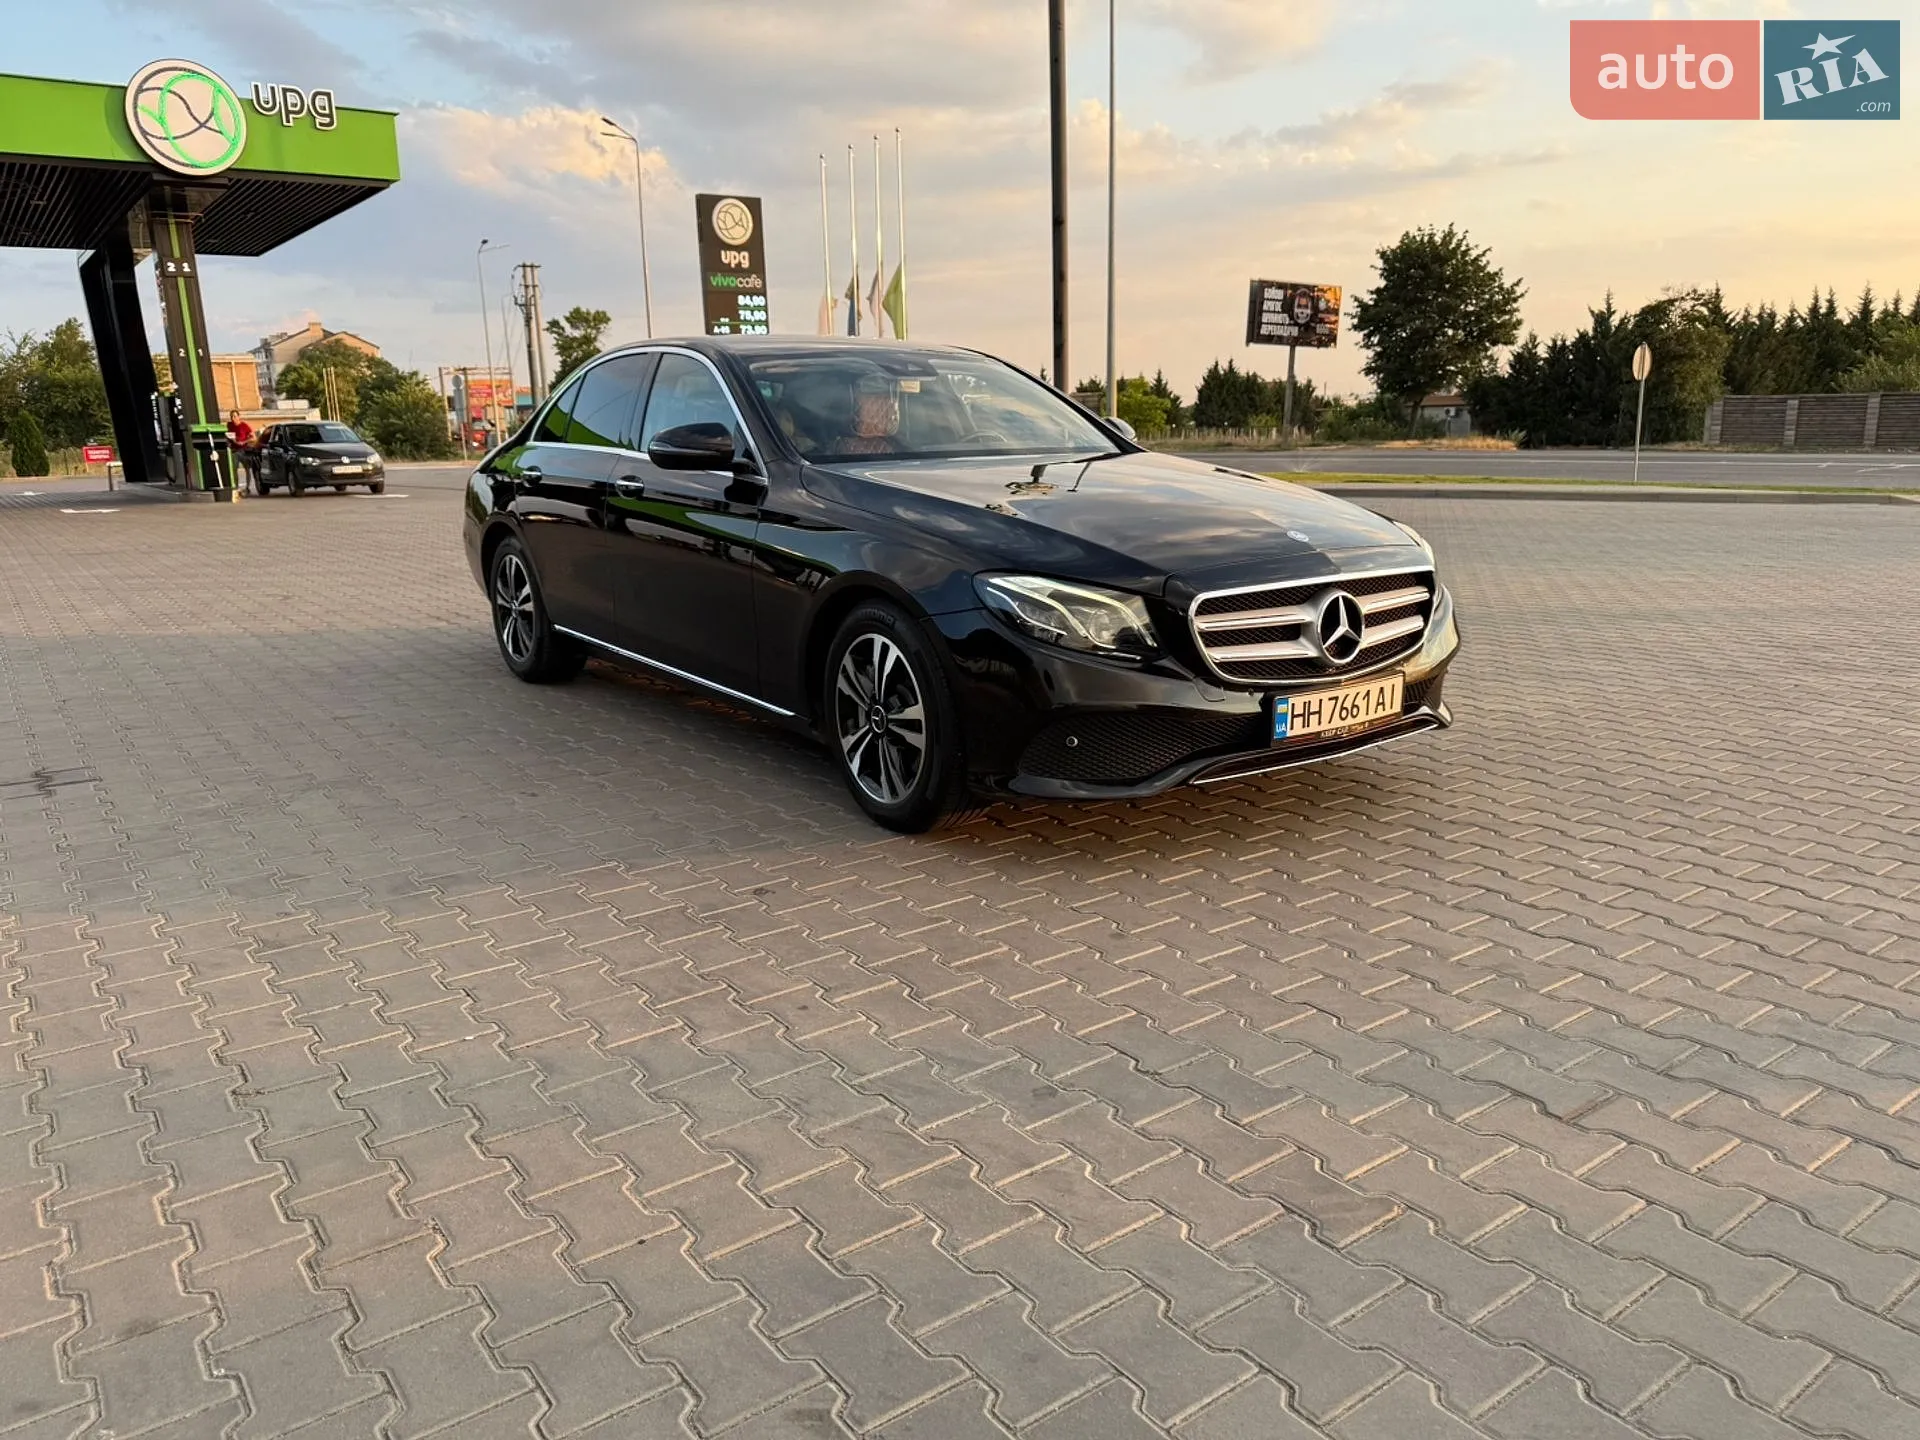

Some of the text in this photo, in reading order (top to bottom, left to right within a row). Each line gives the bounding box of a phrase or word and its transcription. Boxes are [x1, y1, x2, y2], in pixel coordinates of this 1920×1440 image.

[250, 82, 337, 131] upg
[721, 250, 750, 268] upg
[167, 261, 192, 272] 2 1
[179, 348, 186, 357] 2
[1290, 698, 1323, 731] HH
[1328, 689, 1371, 725] 7661
[1374, 683, 1396, 715] AI
[1276, 723, 1288, 733] UA
